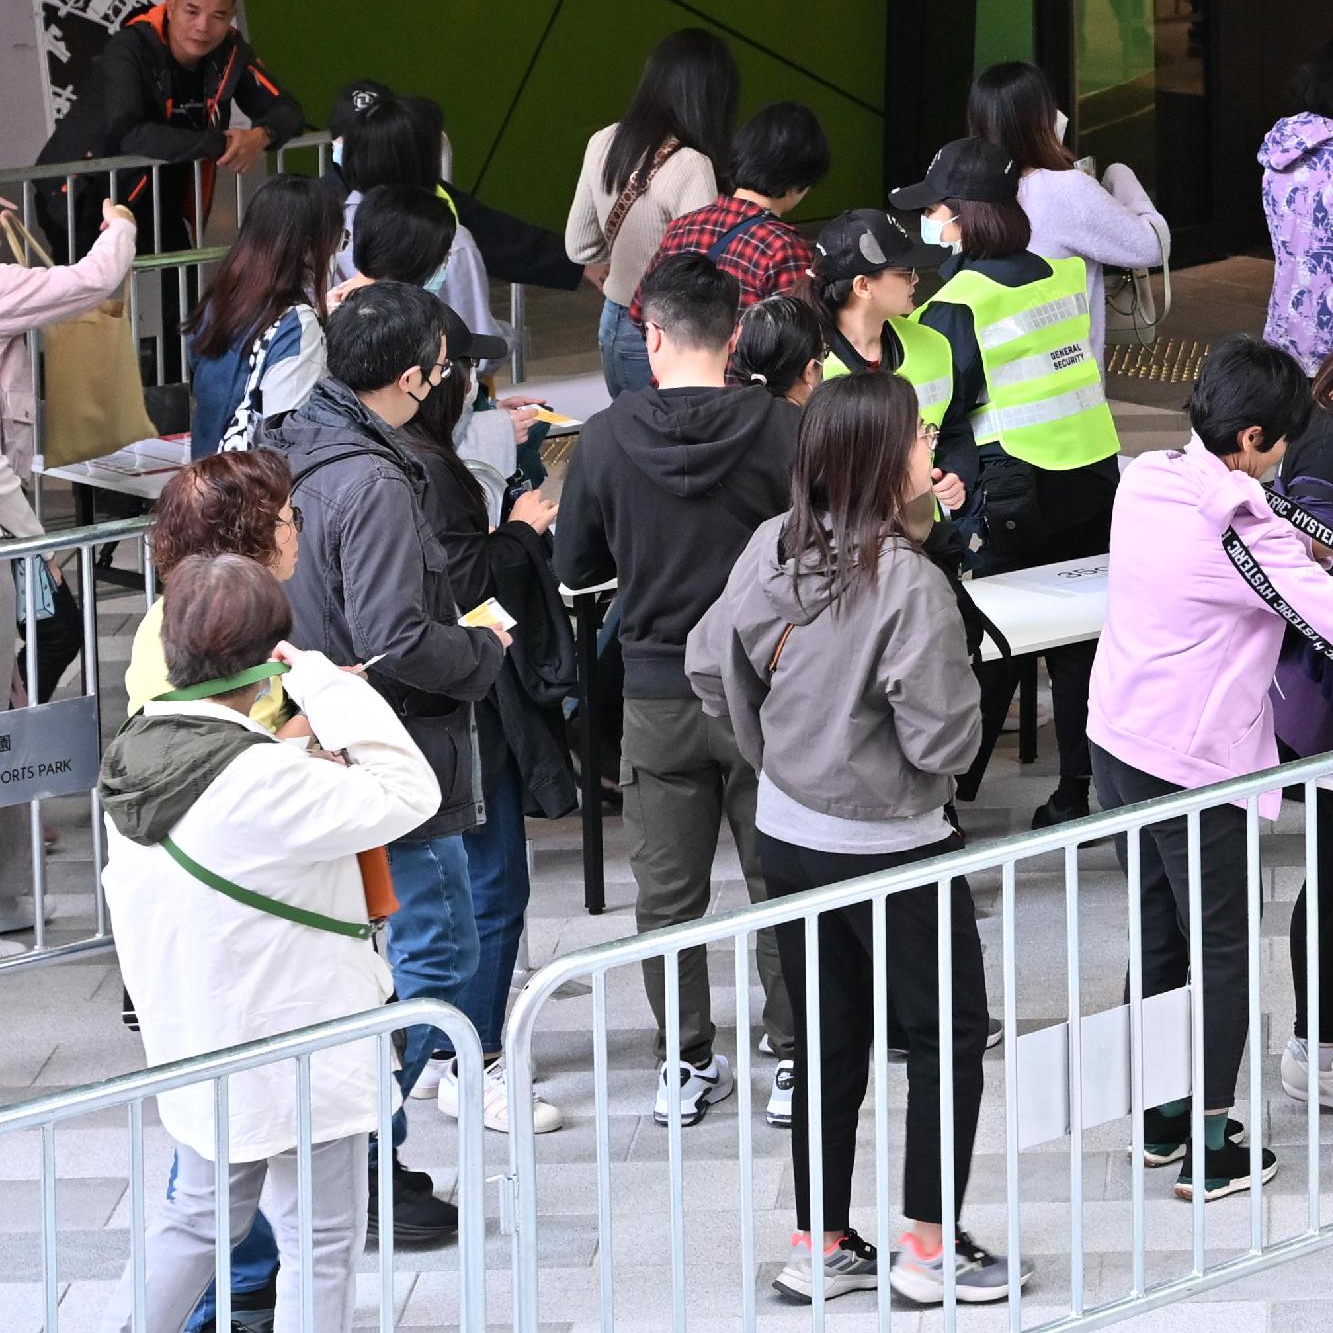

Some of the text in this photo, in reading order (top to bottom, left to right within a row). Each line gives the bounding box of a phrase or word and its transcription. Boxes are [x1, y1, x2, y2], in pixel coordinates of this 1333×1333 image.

[1050, 343, 1082, 360] GENERAL
[1053, 353, 1084, 370] SECURITY
[1227, 540, 1276, 601] HYSTERIC
[0, 759, 72, 784] ORTS PARK
